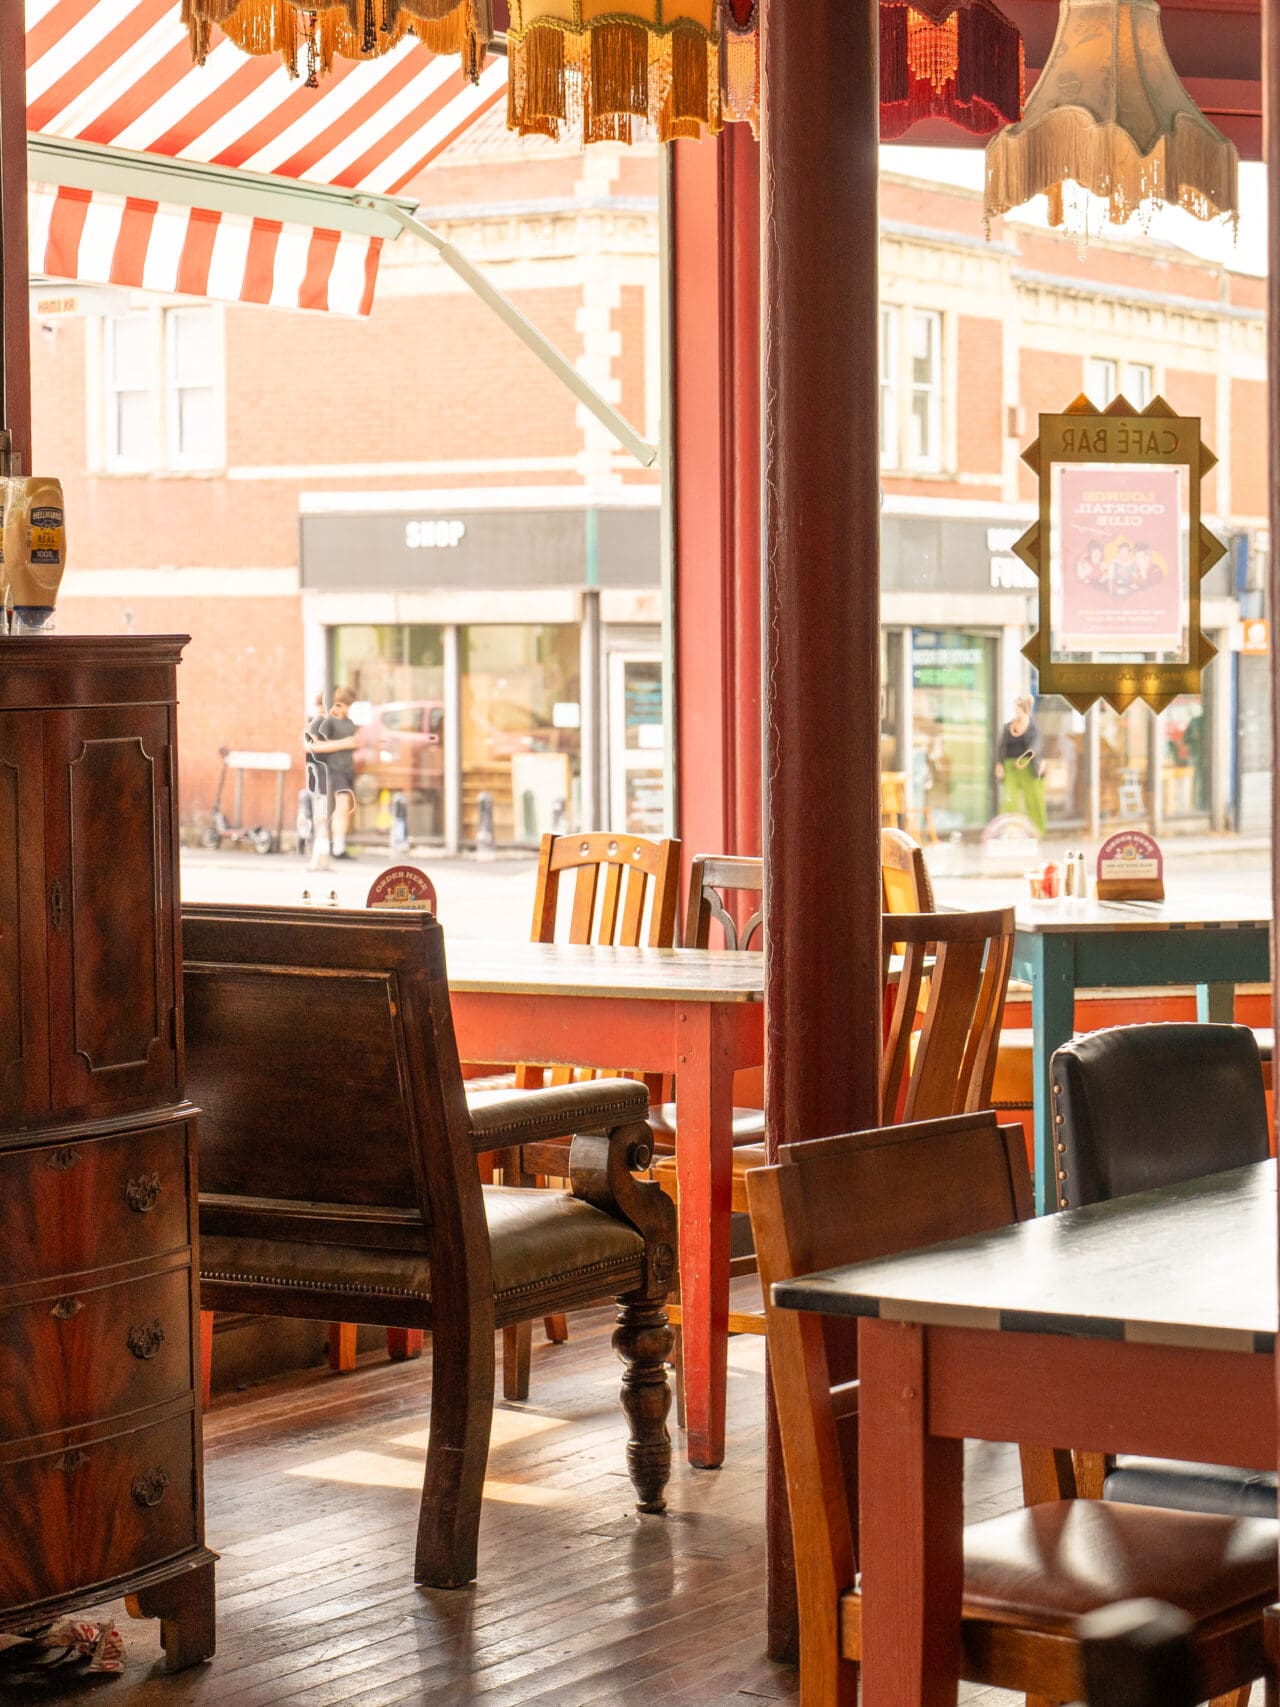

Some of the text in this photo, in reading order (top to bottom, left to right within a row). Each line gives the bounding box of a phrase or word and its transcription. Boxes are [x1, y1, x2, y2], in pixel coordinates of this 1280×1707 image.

[406, 520, 465, 548] SHOP
[1105, 834, 1132, 853] ORDER
[375, 871, 429, 894] ORDER HERE
